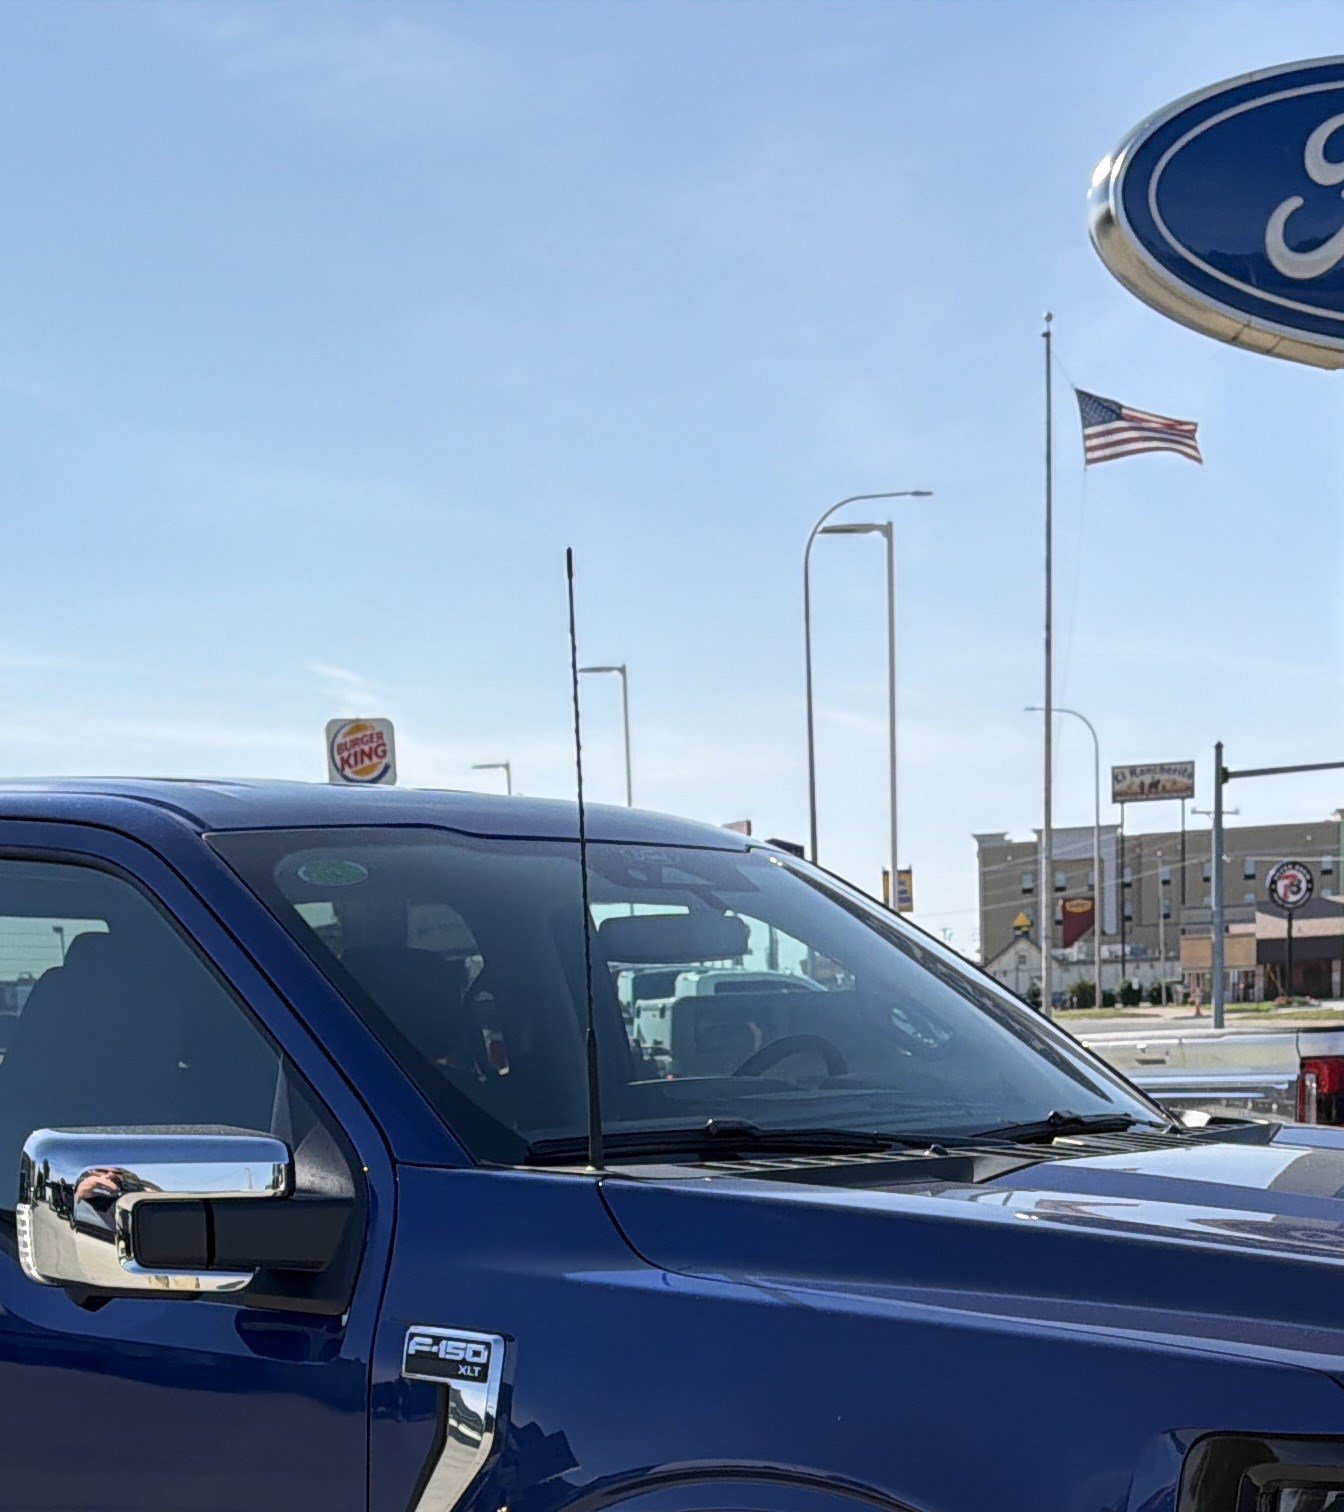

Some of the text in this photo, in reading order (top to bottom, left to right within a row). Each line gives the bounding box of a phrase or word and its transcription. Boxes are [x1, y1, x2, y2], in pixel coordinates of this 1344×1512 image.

[337, 731, 385, 756] BURGER
[339, 743, 388, 773] KING
[408, 1336, 488, 1364] F-150
[458, 1364, 482, 1377] XLT
